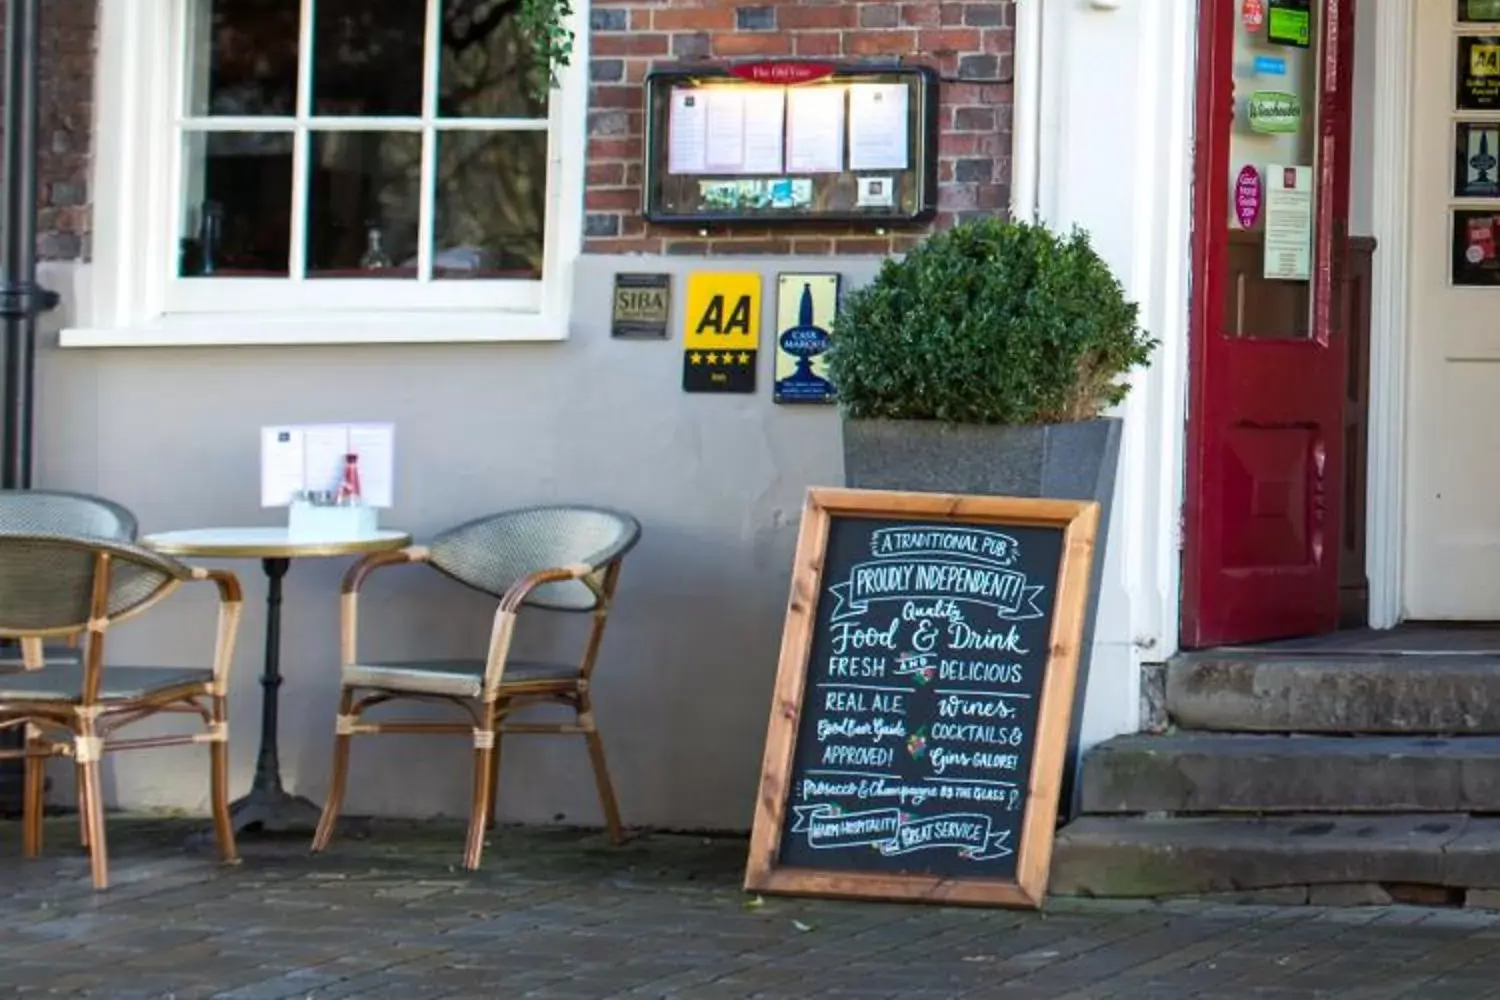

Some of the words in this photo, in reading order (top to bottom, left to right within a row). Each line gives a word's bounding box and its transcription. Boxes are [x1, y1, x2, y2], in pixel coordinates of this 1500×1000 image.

[618, 291, 665, 311] SIBA
[696, 295, 752, 334] AA
[881, 534, 893, 552] A
[894, 532, 979, 553] TRADITIONAL
[981, 537, 1008, 557] PUB
[857, 564, 915, 597] PROUDLY
[915, 565, 1021, 603] INDEPENDENT!
[902, 600, 964, 623] Quality
[829, 617, 900, 655] Food
[912, 619, 940, 651] &
[947, 621, 1030, 654] Drink
[828, 656, 886, 677] FRESH
[939, 659, 1023, 684] DELICIOUS
[825, 692, 867, 712] REAL
[871, 693, 904, 714] ALE
[931, 721, 1007, 745] COCKTAILS
[821, 745, 894, 767] APPROVED!
[929, 747, 971, 774] Gins
[934, 821, 984, 842] SERVICE
